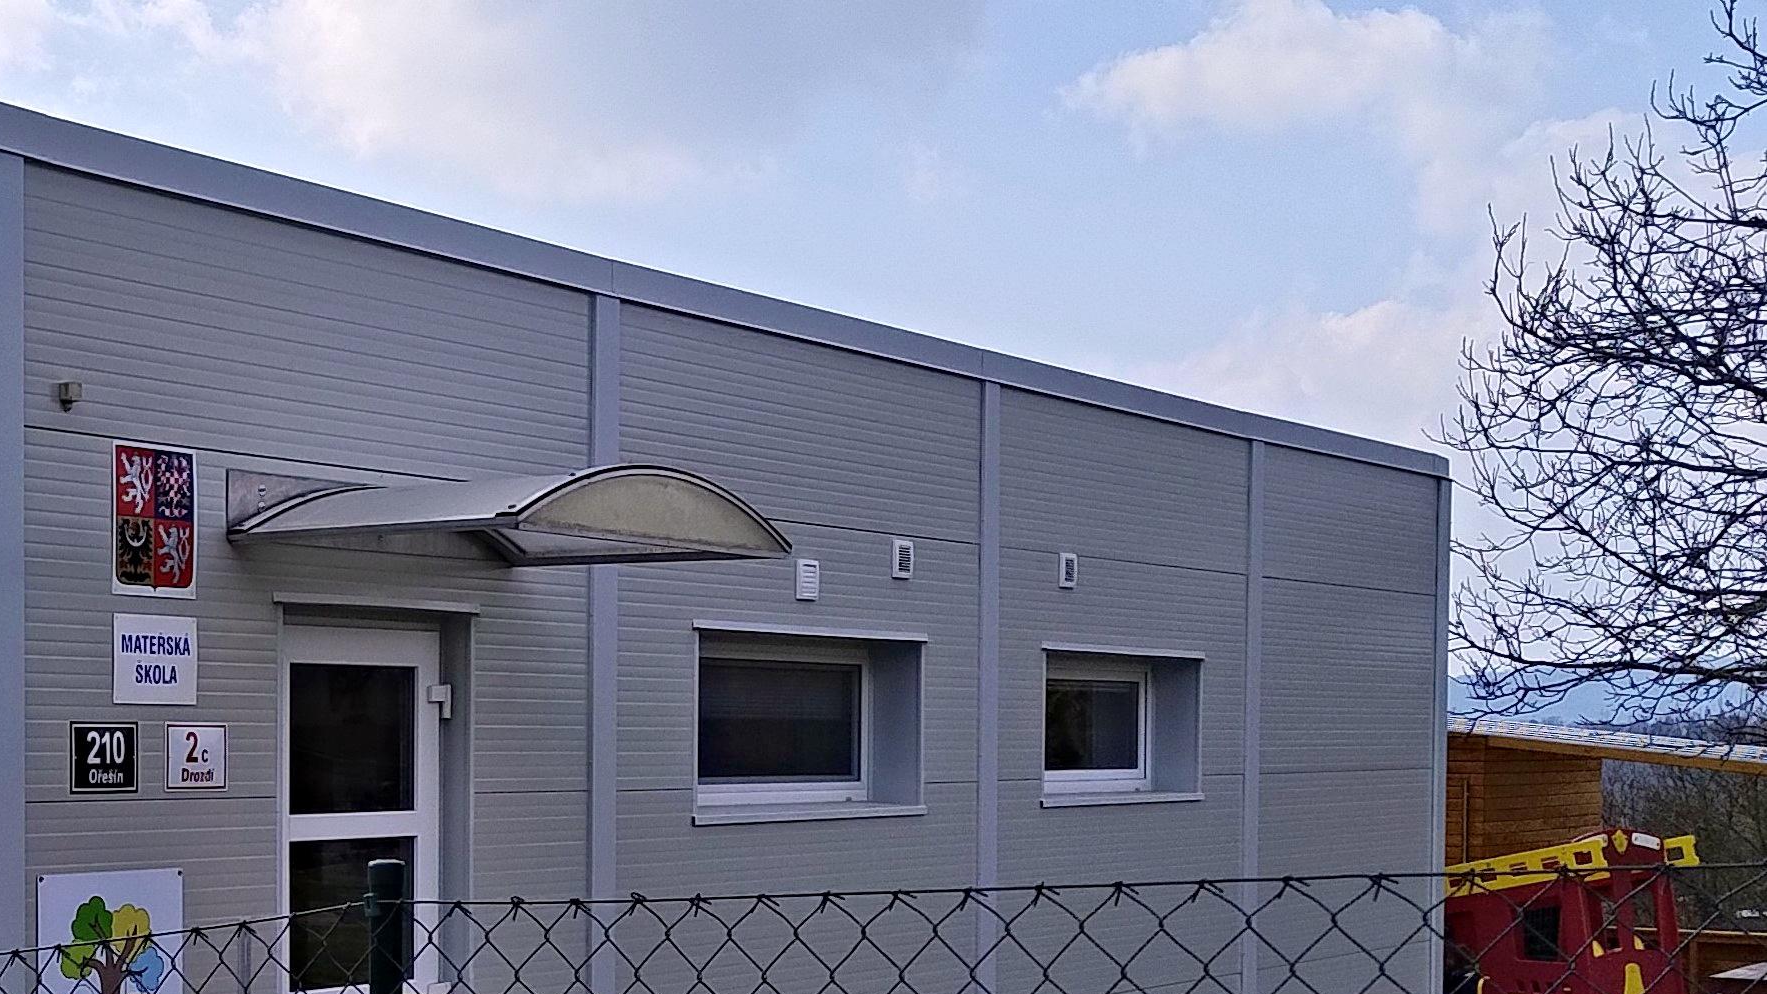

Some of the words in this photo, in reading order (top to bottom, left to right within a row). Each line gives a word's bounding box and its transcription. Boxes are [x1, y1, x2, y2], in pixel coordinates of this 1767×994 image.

[121, 632, 191, 656] MATEŘSKÁ
[135, 660, 178, 685] ŠKOLA
[86, 731, 126, 765] 210
[88, 768, 124, 784] Ořešín
[181, 767, 215, 783] Drozdí
